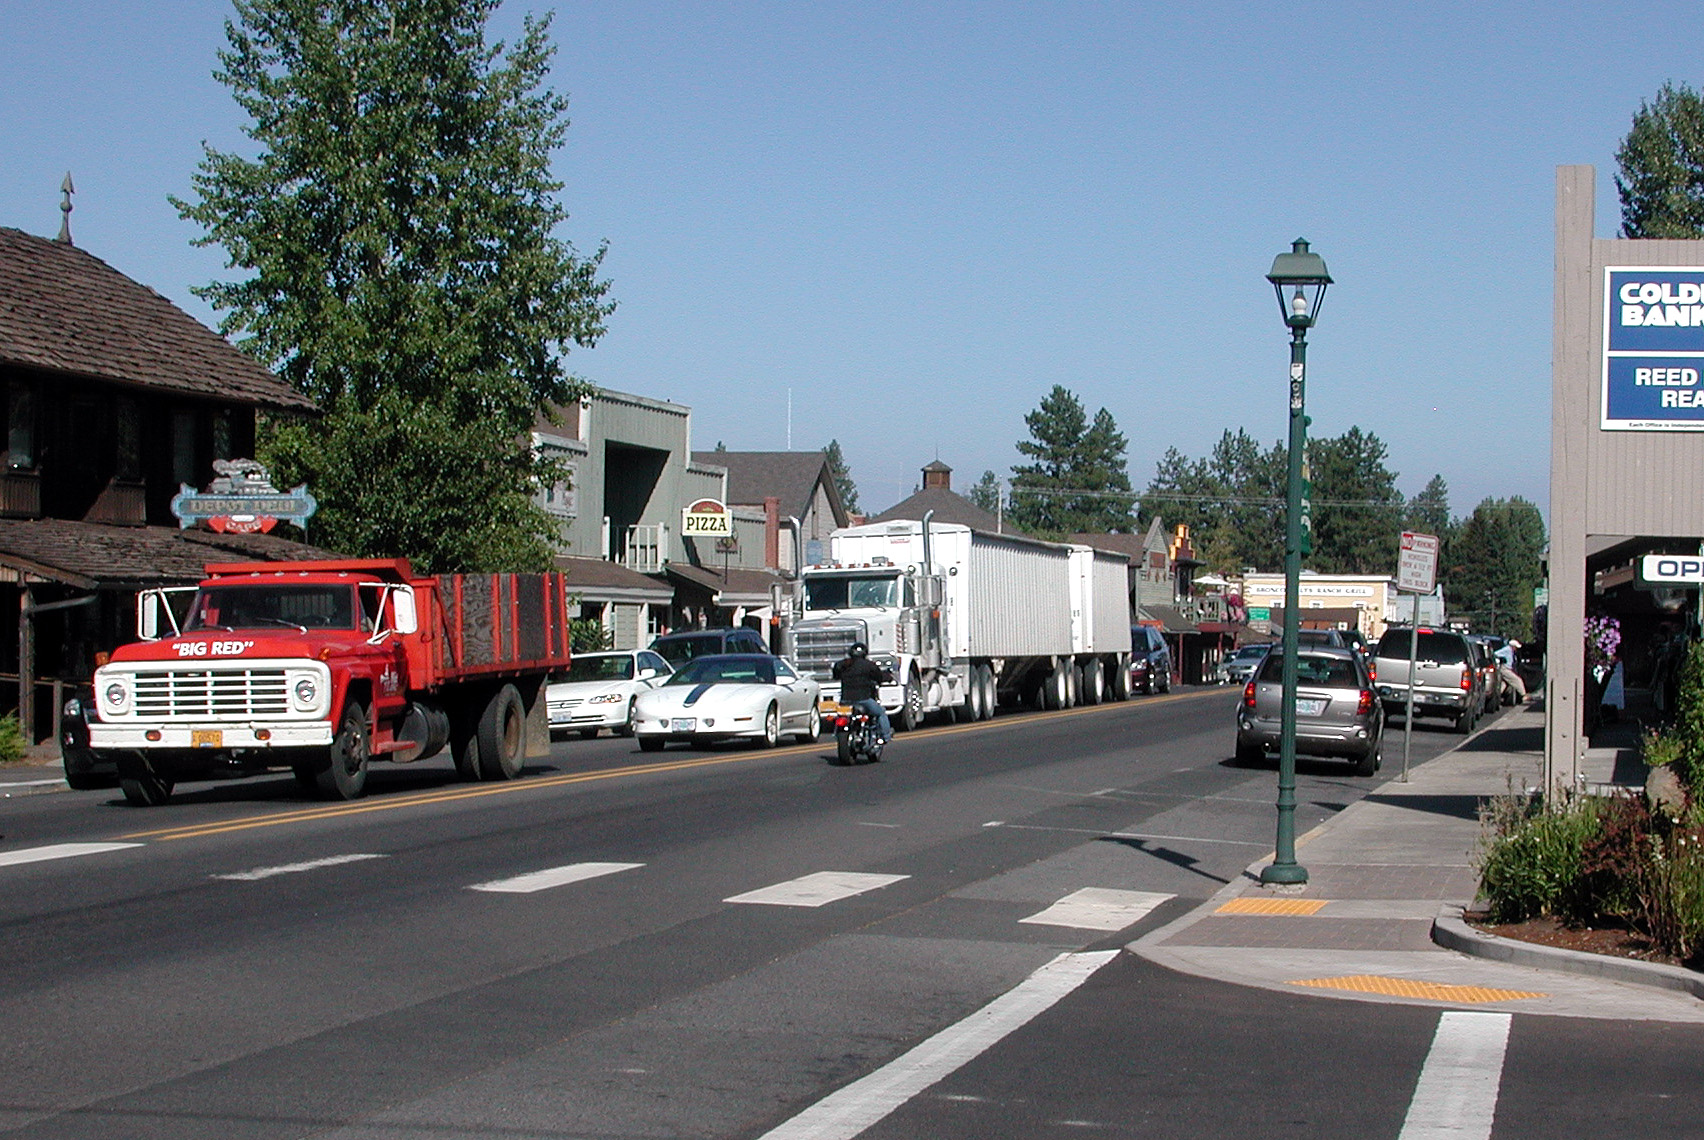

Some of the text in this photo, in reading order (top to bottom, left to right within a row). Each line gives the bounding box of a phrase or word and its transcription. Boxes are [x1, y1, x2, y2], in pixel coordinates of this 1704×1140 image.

[1619, 282, 1704, 305] COLD
[1635, 367, 1699, 386] REED
[1661, 389, 1704, 408] REA
[190, 499, 245, 512] DEPOT
[686, 517, 727, 531] PIZZA
[1658, 561, 1704, 577] OP
